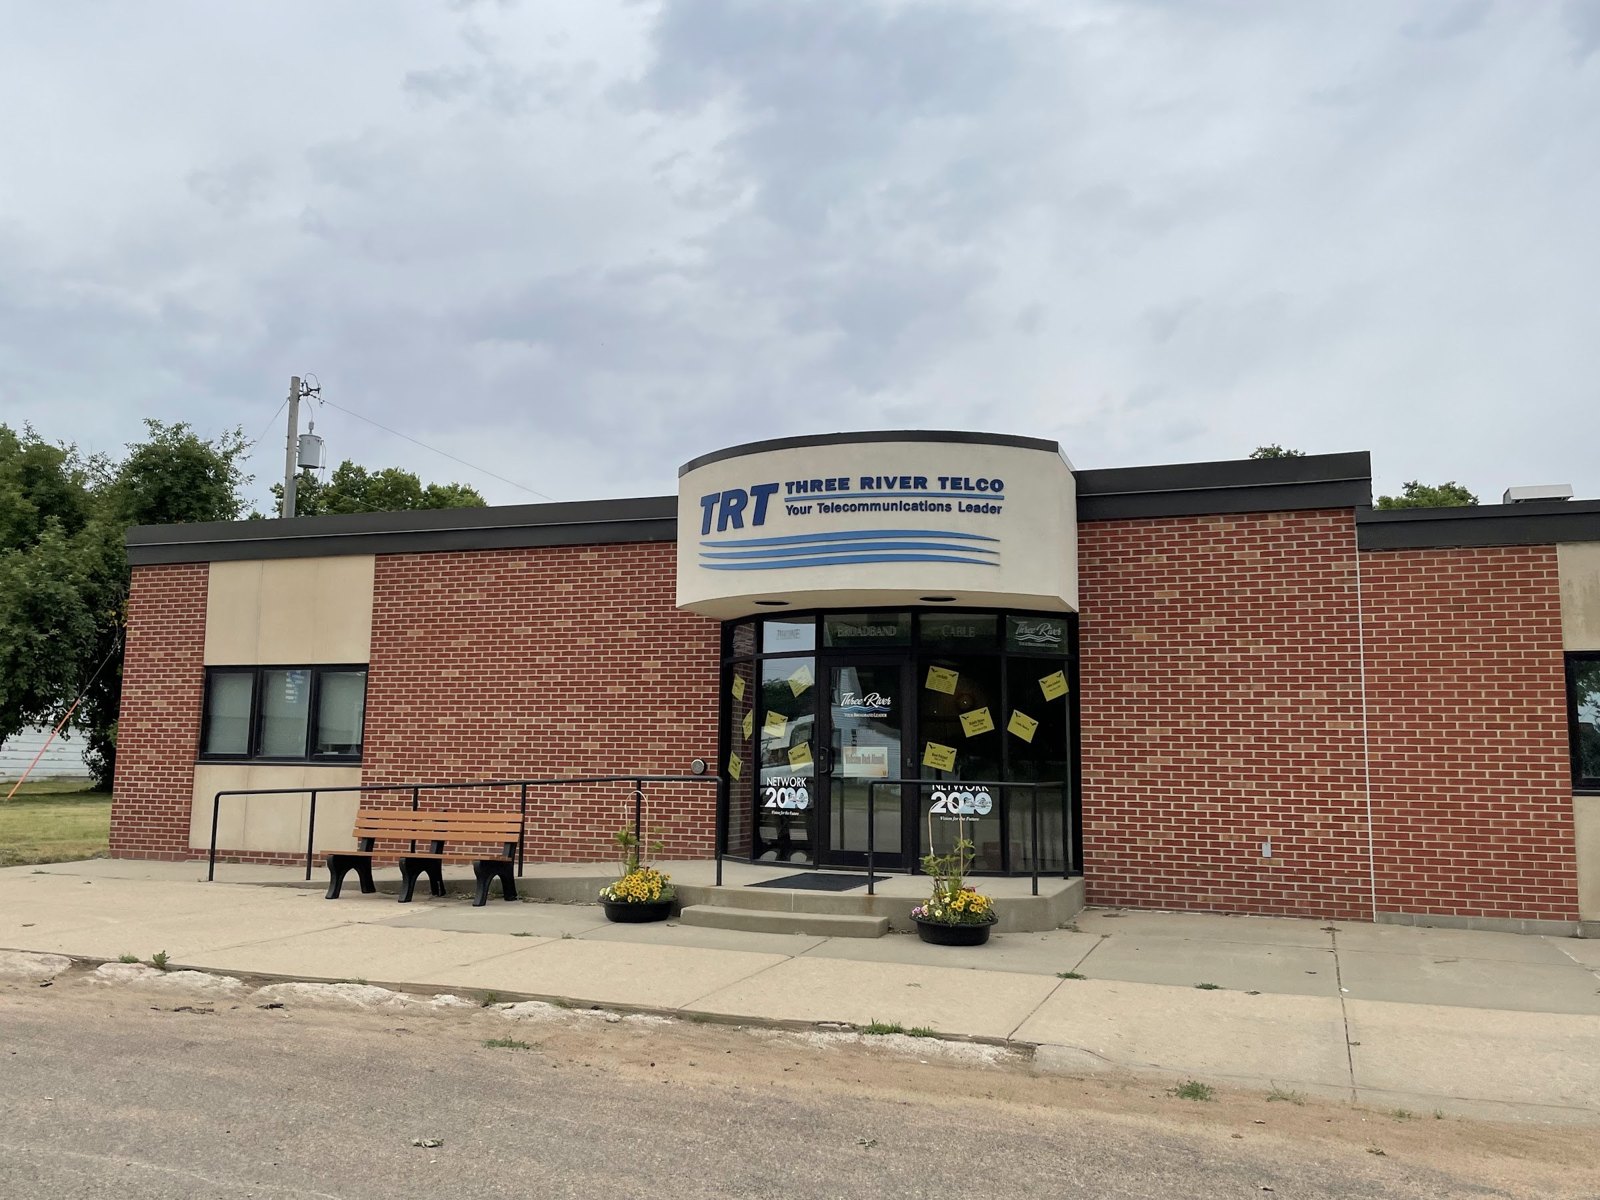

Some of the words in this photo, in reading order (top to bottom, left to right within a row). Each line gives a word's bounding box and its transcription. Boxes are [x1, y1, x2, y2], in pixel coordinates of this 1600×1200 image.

[785, 477, 850, 494] THREE
[860, 476, 928, 490] RIVER
[938, 476, 1004, 492] TELCO
[700, 483, 779, 535] TRT
[786, 503, 812, 516] Your
[817, 500, 952, 514] Telecommunications
[958, 501, 1003, 515] Leader
[841, 692, 863, 706] Three
[864, 692, 892, 708] River
[766, 776, 807, 787] NETWORK
[764, 787, 809, 809] 2020
[930, 791, 993, 816] 2020
